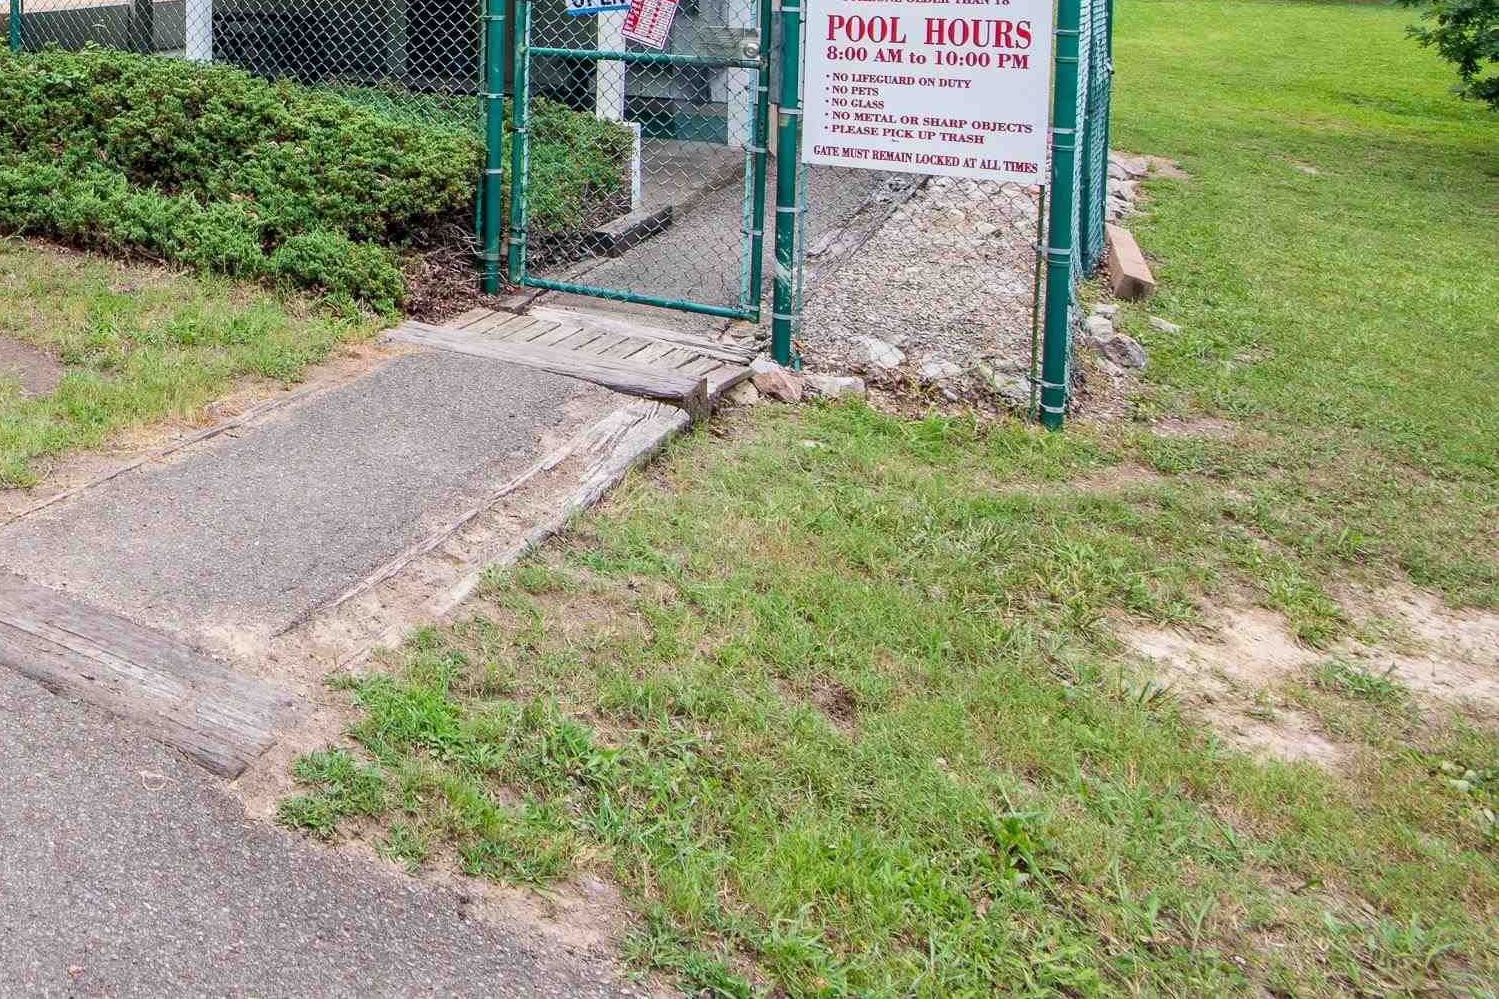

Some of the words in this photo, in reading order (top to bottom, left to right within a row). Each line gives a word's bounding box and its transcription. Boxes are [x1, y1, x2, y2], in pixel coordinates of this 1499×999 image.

[826, 15, 906, 43] POOL
[924, 18, 1031, 49] HOURS
[827, 46, 867, 61] 8:00
[874, 48, 903, 63] AM
[909, 52, 926, 64] to
[935, 51, 990, 67] 10:00
[997, 53, 1029, 69] PM
[832, 85, 848, 94] NO
[851, 87, 879, 96] PETS
[833, 73, 848, 81] NO
[852, 74, 915, 85] LIFEGUARD
[918, 77, 936, 86] ON
[939, 79, 971, 88] DUTY
[832, 98, 847, 106] NO
[851, 99, 884, 109] GLASS
[832, 111, 850, 120] NO
[854, 112, 896, 123] METAL
[900, 116, 918, 125] OR
[923, 117, 967, 128] SHARP
[972, 121, 1033, 133] OBJECTS
[832, 125, 879, 135] PLEASE
[883, 128, 915, 138] PICK
[918, 131, 936, 140] UP
[940, 133, 984, 144] TRASH
[814, 145, 839, 156] GATE
[842, 148, 870, 159] MUST
[872, 150, 912, 162] REMAIN
[916, 154, 959, 166] LOCKED
[963, 158, 977, 168] AT
[980, 160, 1001, 170] ALL
[1003, 161, 1038, 173] TIMES
